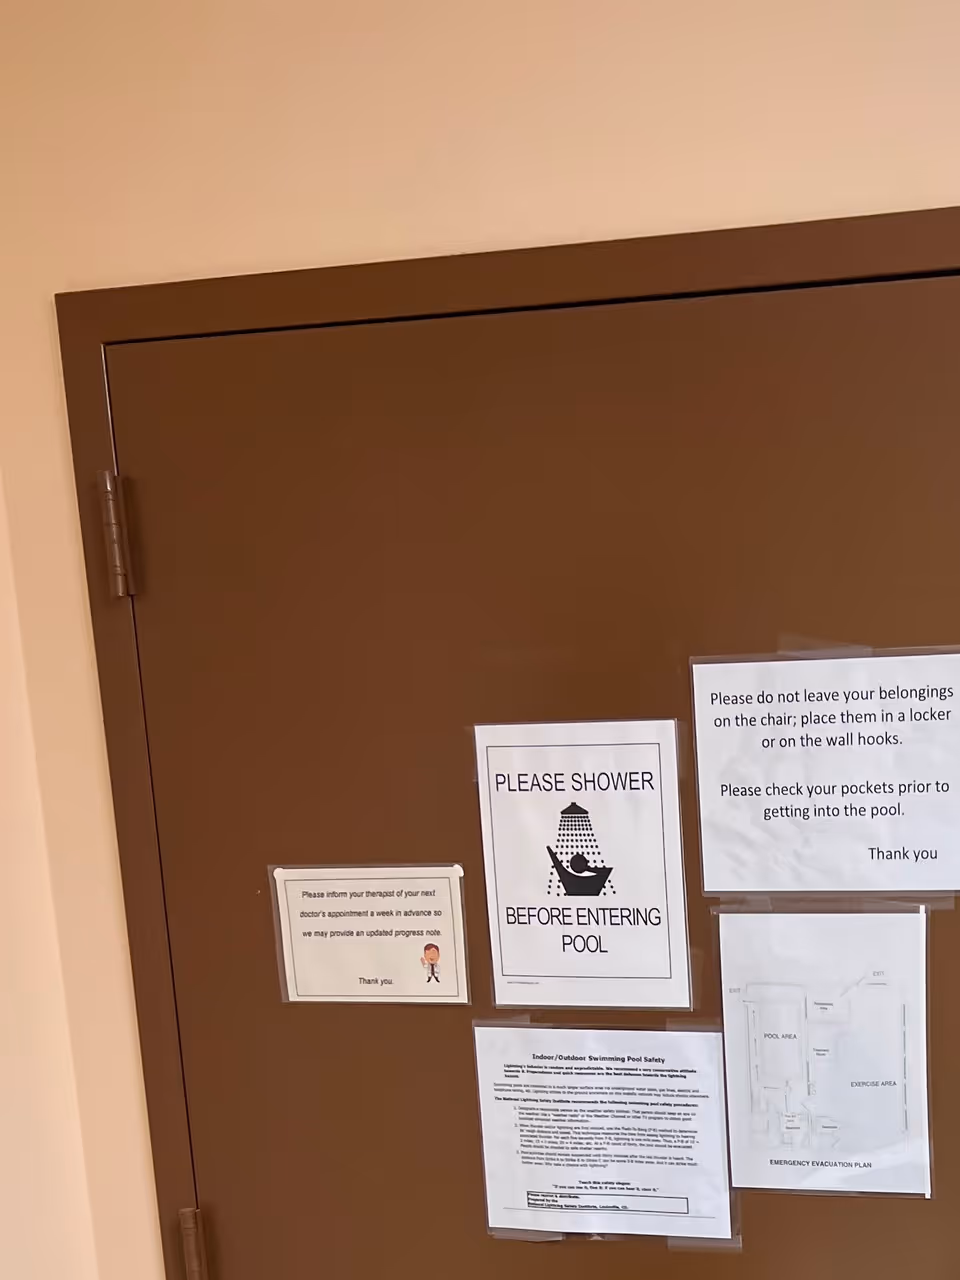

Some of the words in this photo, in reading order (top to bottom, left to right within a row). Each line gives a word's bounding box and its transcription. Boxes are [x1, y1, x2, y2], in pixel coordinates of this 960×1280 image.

[710, 692, 753, 705] Please
[757, 691, 773, 704] do
[777, 691, 800, 703] not
[804, 688, 839, 702] leave
[843, 689, 875, 705] your
[879, 685, 954, 703] belongings
[714, 715, 731, 727] on
[734, 713, 757, 727] the
[760, 713, 797, 728] chair;
[801, 711, 836, 727] place
[840, 710, 877, 724] them
[881, 710, 894, 722] in
[897, 711, 905, 722] a
[909, 707, 952, 722] locker
[761, 737, 775, 749] or
[779, 736, 796, 748] on
[800, 734, 822, 748] the
[826, 733, 853, 747] wall
[857, 732, 902, 746] hooks.
[495, 773, 565, 792] PLEASE
[571, 772, 655, 792] SHOWER
[720, 784, 761, 797] Please
[765, 782, 803, 796] check
[806, 783, 837, 798] your
[841, 781, 894, 797] pockets
[898, 780, 931, 796] prior
[935, 780, 949, 793] to
[763, 805, 810, 820] getting
[813, 805, 840, 817] into
[843, 803, 867, 817] the
[870, 803, 905, 819] pool.
[868, 847, 909, 860] Thank
[913, 849, 938, 862] you
[349, 892, 364, 900] your
[366, 890, 395, 899] therapist
[396, 889, 403, 897] of
[404, 890, 420, 898] your
[327, 910, 369, 918] appointment
[506, 907, 572, 926] BEFORE
[576, 907, 661, 926] ENTERING
[330, 930, 354, 938] provide
[366, 929, 393, 937] updated
[394, 930, 424, 938] progress
[562, 935, 608, 953] POOL
[532, 1053, 586, 1061] Indoor/Outdoor
[588, 1055, 625, 1063] Swimming
[770, 1159, 810, 1167] EMERGENCY
[811, 1160, 853, 1168] EVACUATION
